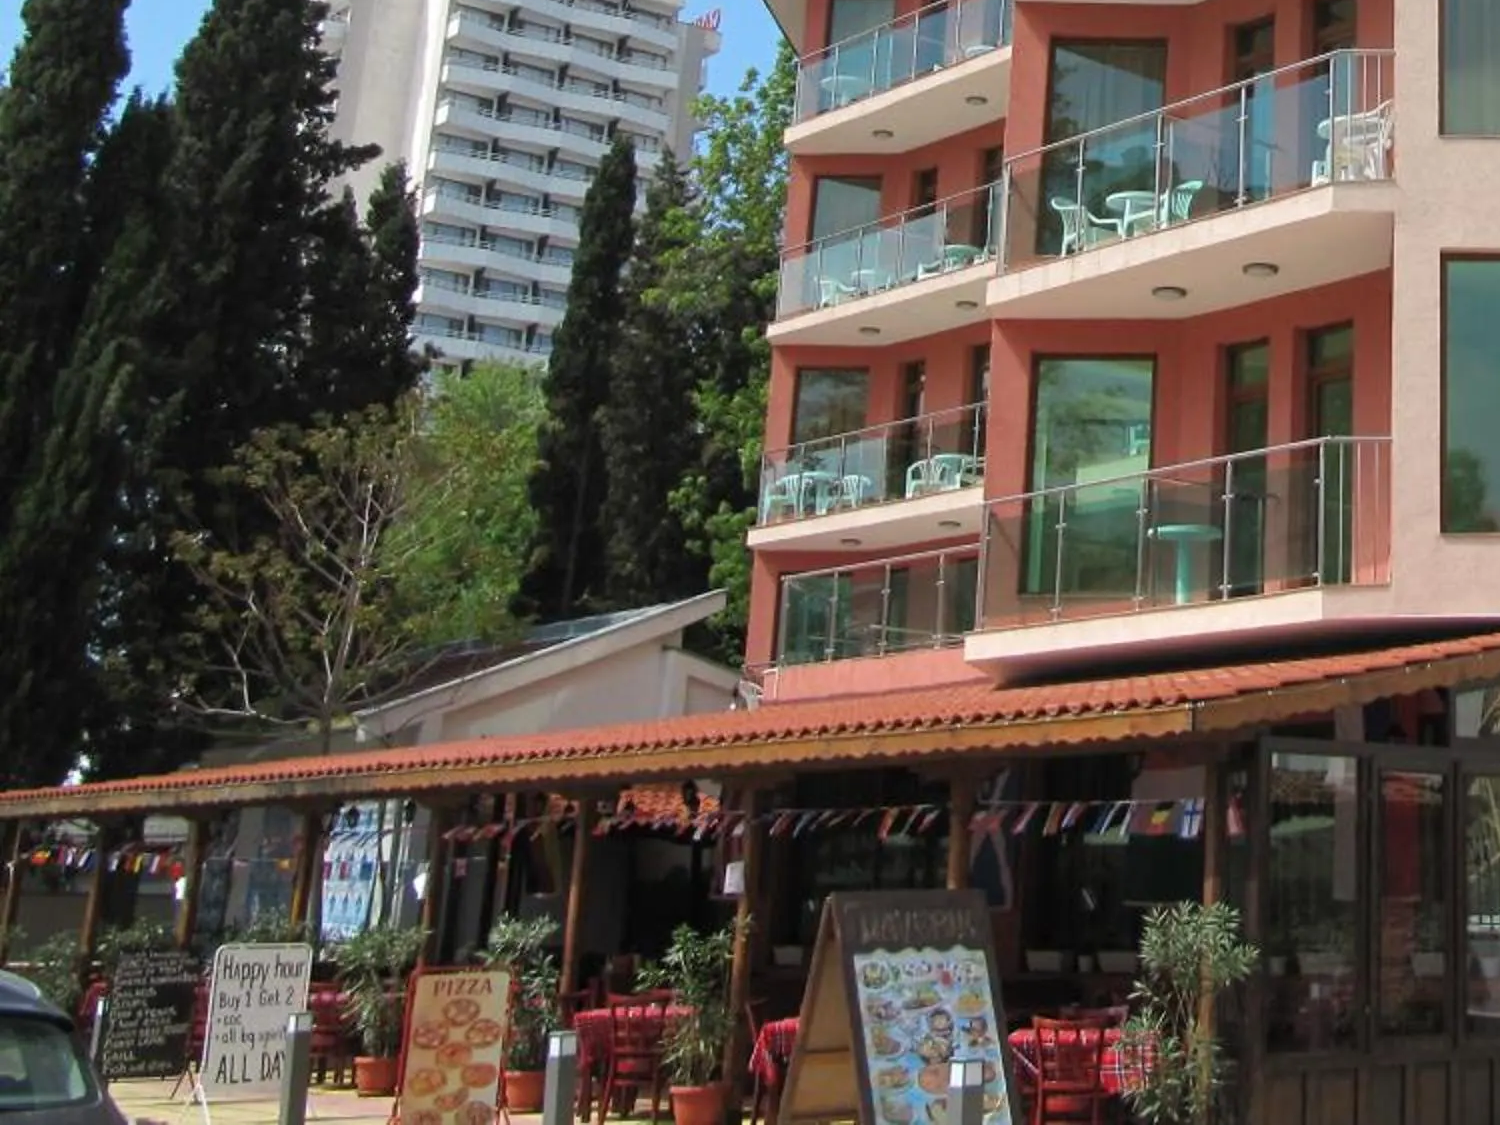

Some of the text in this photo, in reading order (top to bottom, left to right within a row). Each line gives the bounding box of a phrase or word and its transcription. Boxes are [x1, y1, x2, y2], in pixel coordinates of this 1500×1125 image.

[219, 991, 240, 1010] Buy
[260, 989, 280, 1005] Get
[286, 985, 295, 1005] 2
[433, 978, 493, 996] PIZZA
[215, 1054, 252, 1083] ALL
